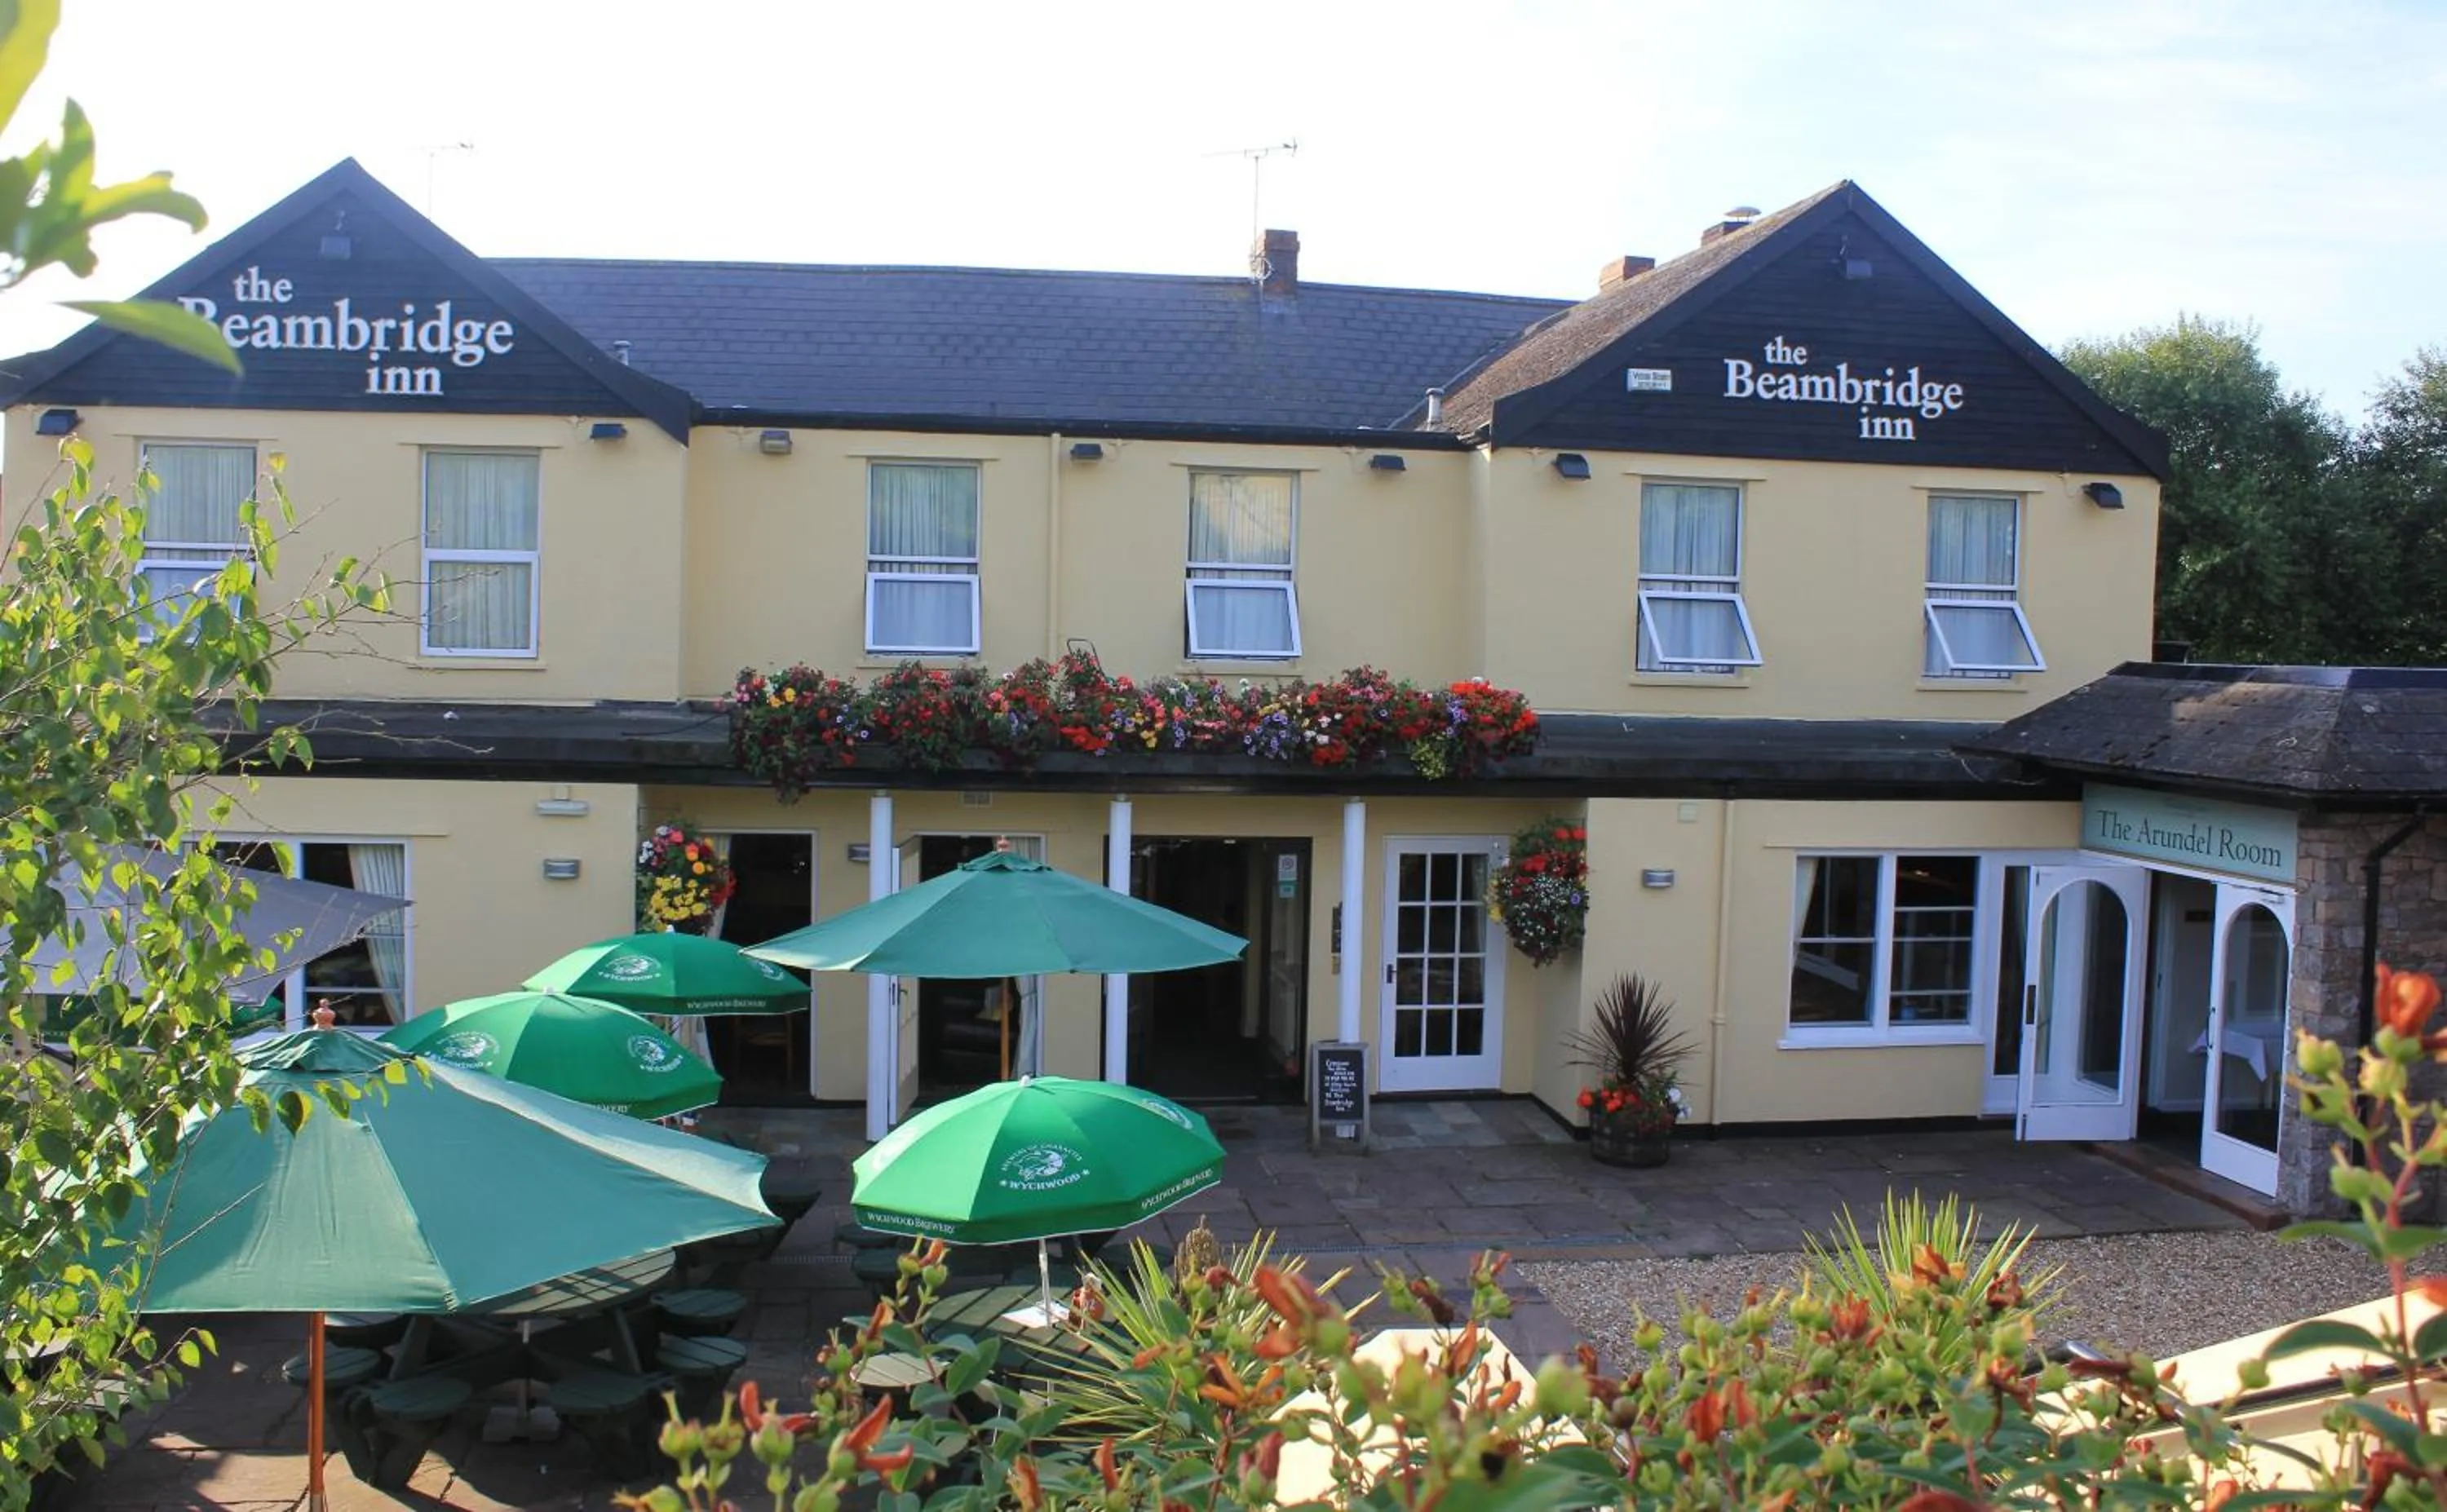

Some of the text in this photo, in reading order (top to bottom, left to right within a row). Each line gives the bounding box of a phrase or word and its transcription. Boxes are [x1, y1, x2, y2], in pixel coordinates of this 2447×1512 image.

[233, 266, 293, 303] the
[1764, 336, 1808, 365] the
[365, 353, 444, 396] inn
[1724, 358, 1964, 419] Beambridge
[1859, 405, 1915, 440] inn
[2096, 809, 2282, 868] The Arundel Room
[1009, 1173, 1081, 1191] WYCHWOOD
